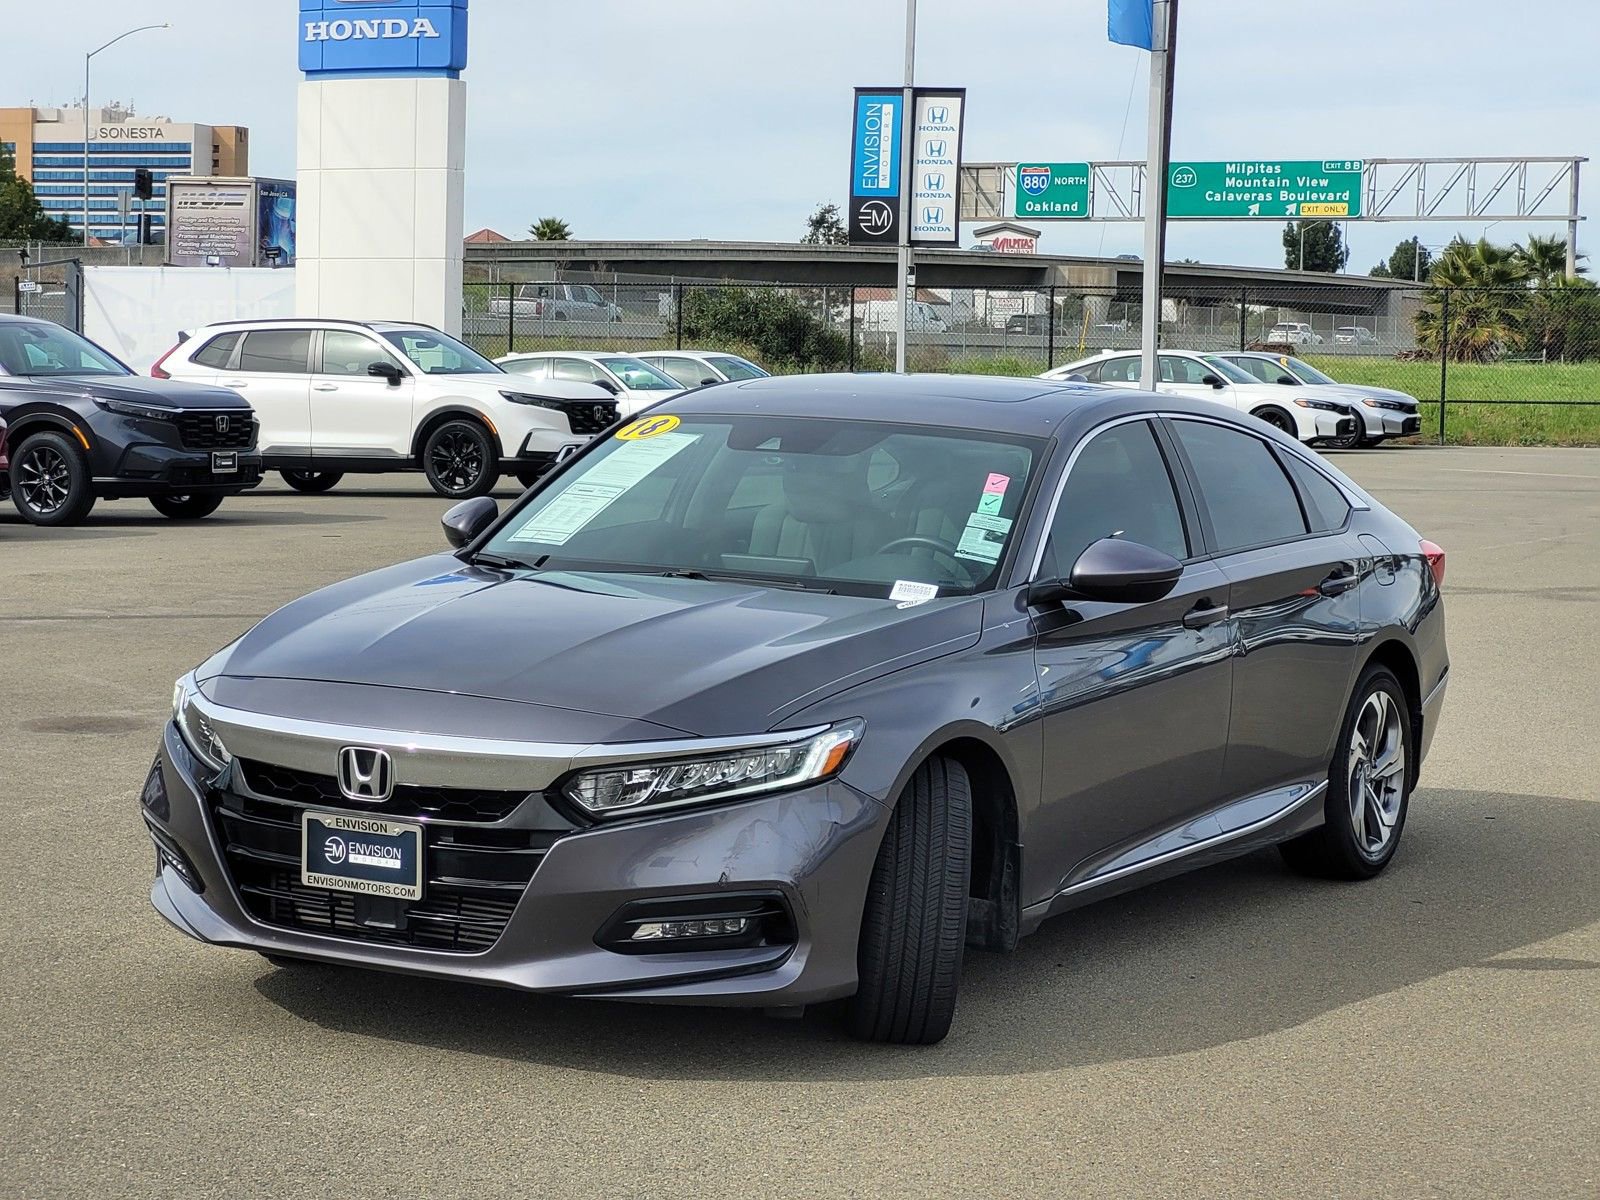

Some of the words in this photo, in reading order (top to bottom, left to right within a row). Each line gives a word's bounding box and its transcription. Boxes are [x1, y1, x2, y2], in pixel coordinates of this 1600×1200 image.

[304, 18, 440, 41] HONDA
[99, 127, 164, 139] SONESTA
[862, 103, 882, 189] ENVISION
[882, 111, 891, 182] MOTORS
[1226, 163, 1282, 176] Milpitas
[1325, 162, 1341, 170] EXIT
[1024, 176, 1048, 189] 880
[1054, 176, 1087, 185] NORTH
[1175, 174, 1193, 184] 237
[1226, 177, 1290, 188] Mountain
[1296, 176, 1329, 187] View
[1205, 190, 1273, 201] Calaveras
[1280, 190, 1350, 201] Boulevard
[1025, 201, 1079, 212] Oakland
[1301, 205, 1319, 213] EXIT
[1324, 205, 1346, 213] ONLY
[992, 237, 1034, 252] MILPITAS
[623, 418, 670, 437] 18
[335, 818, 388, 833] ENVISION
[348, 842, 401, 860] ENVISION
[307, 875, 416, 898] ENVISIONMOTORS.COM
